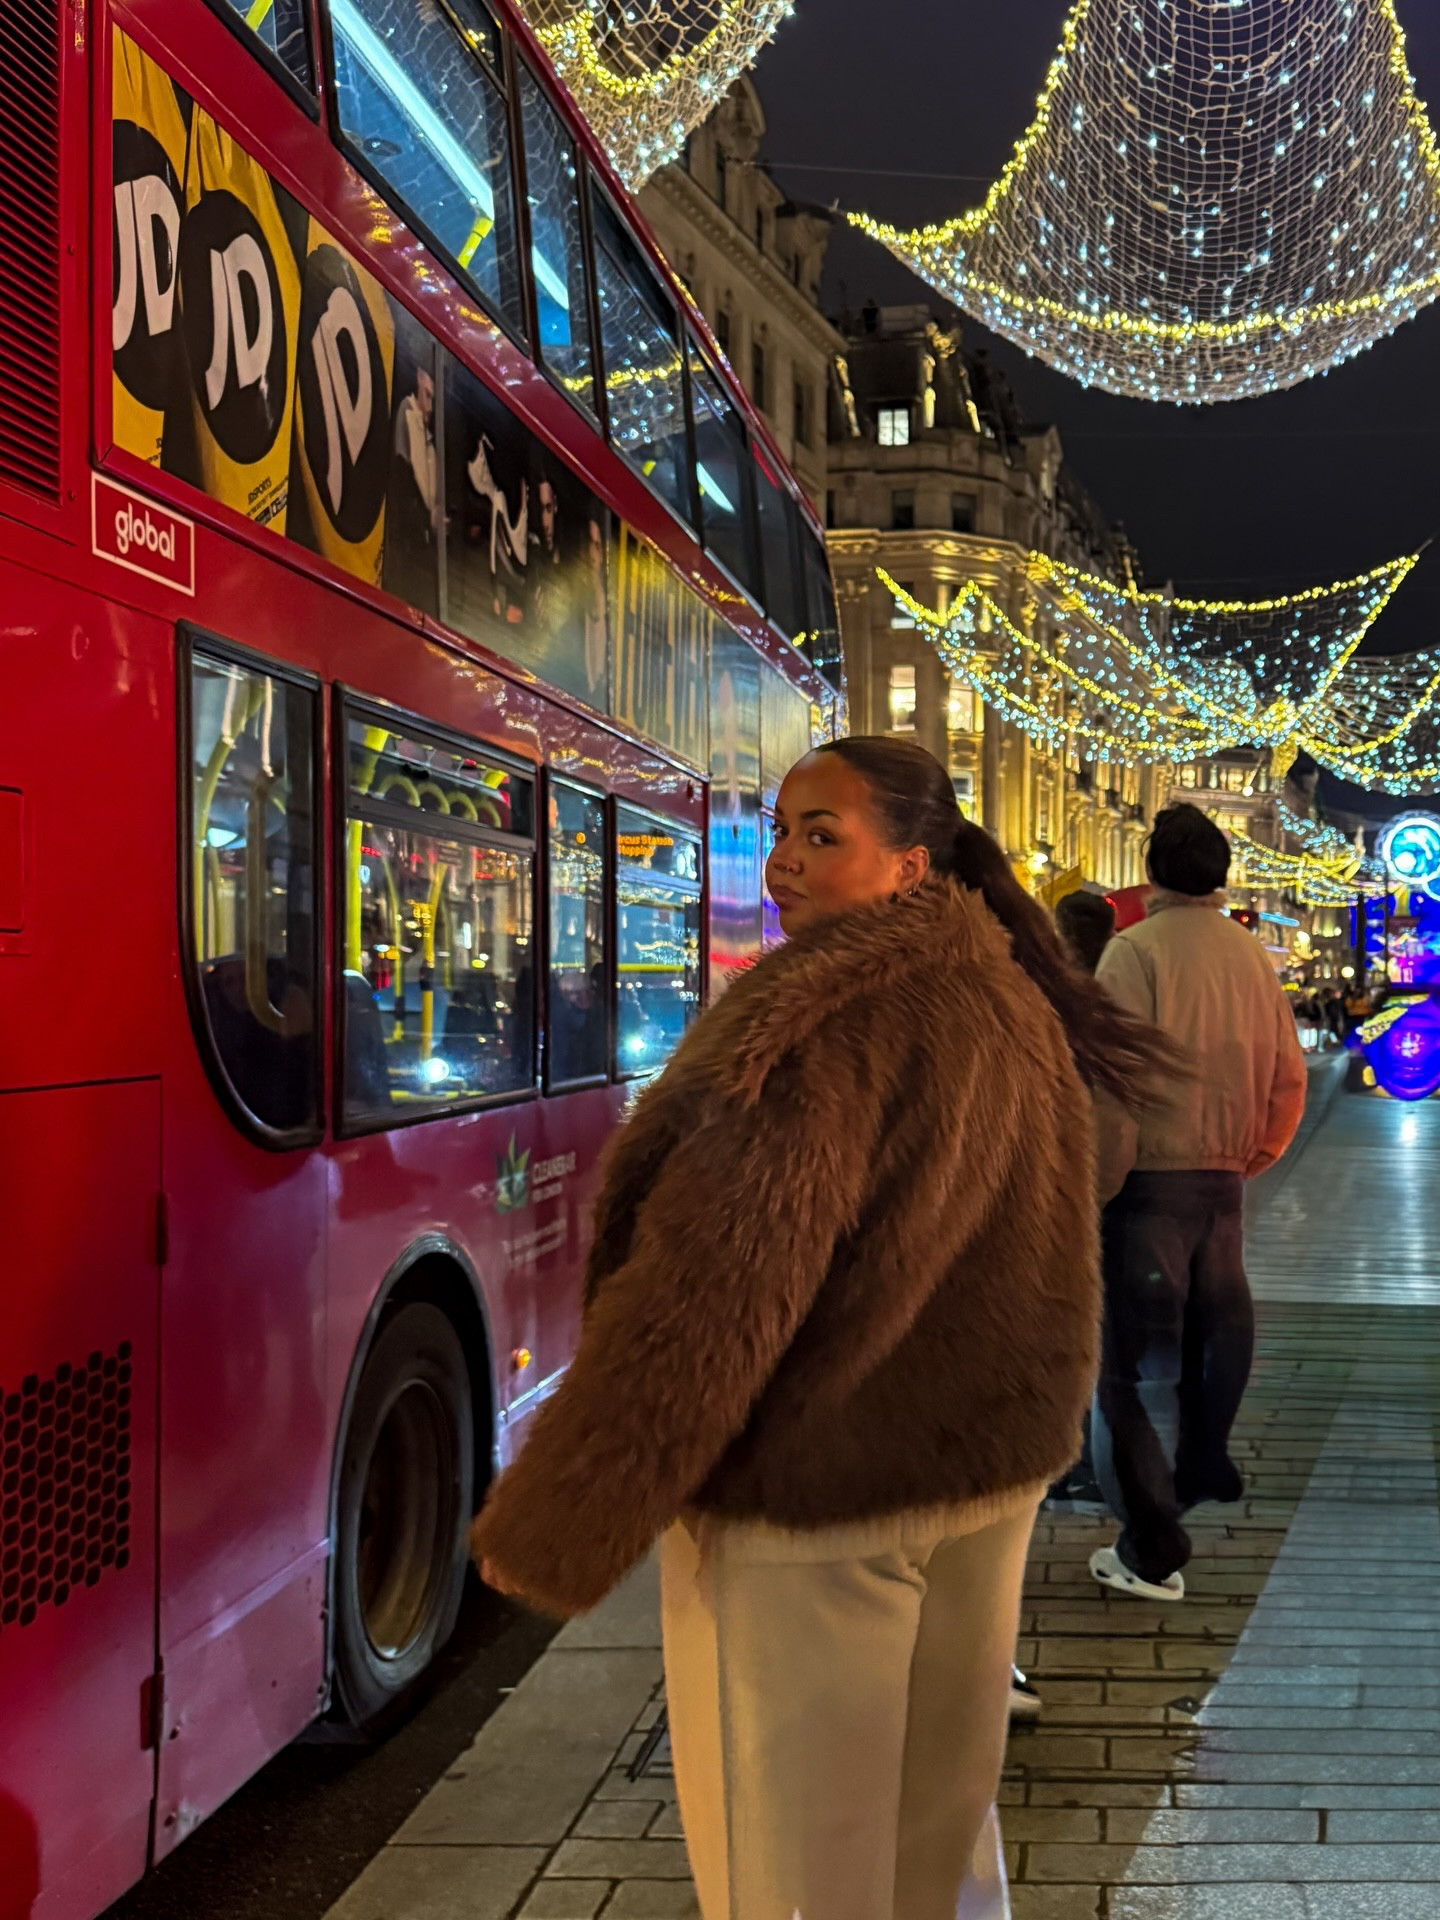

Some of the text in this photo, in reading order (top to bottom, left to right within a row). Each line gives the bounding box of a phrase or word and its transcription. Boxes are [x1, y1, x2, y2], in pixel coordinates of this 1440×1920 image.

[113, 174, 180, 351] JD
[206, 232, 273, 410] JD
[312, 286, 372, 516] JD
[115, 502, 175, 562] global
